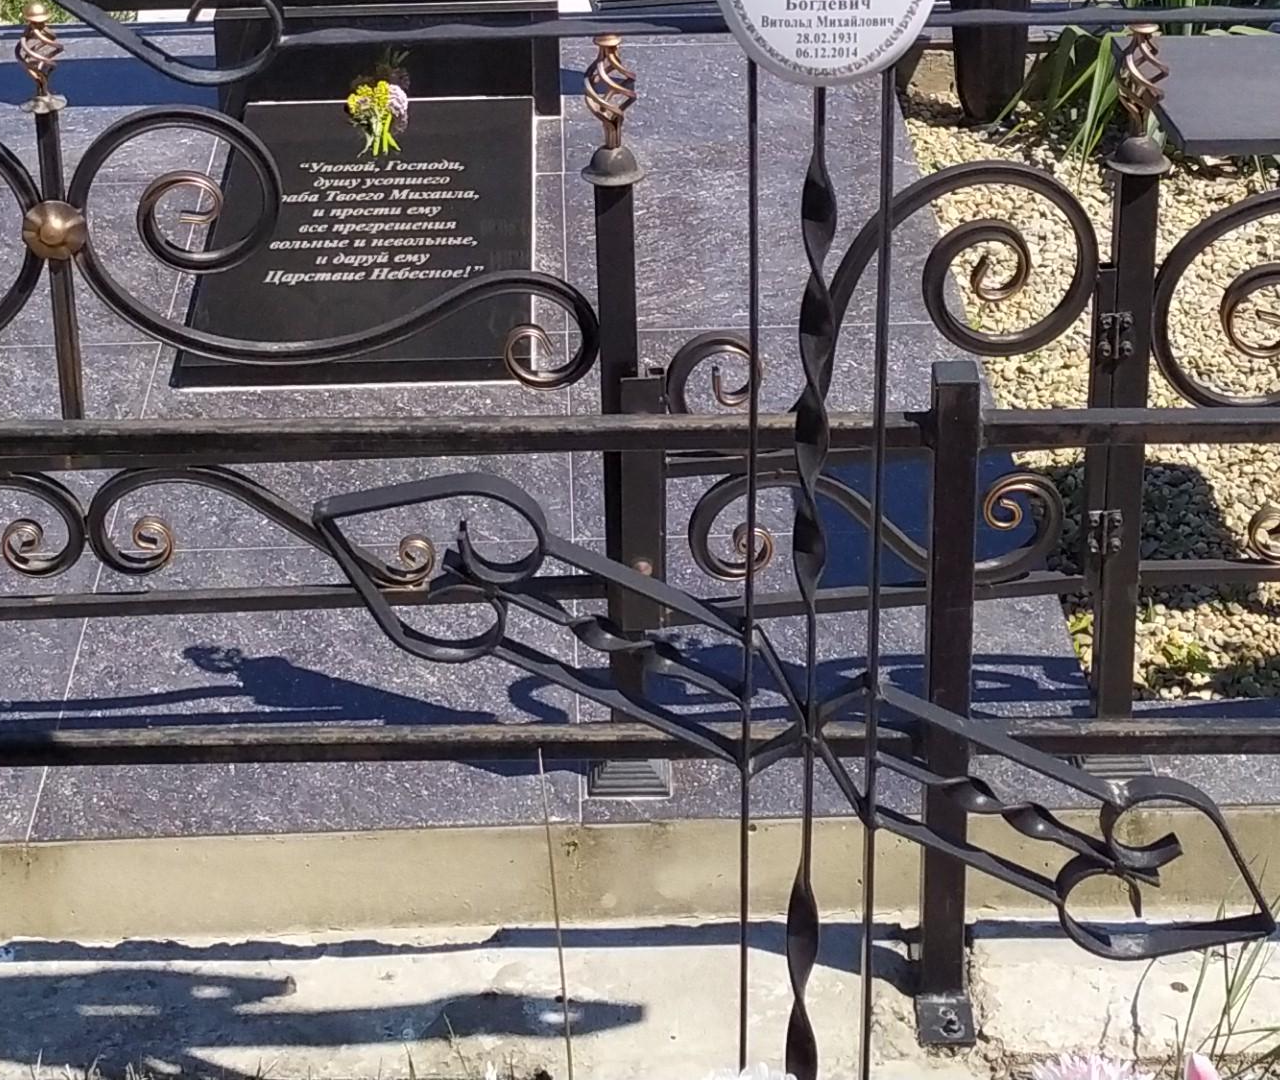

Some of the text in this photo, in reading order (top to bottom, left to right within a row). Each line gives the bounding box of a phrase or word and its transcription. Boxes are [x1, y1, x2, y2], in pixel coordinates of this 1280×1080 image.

[761, 15, 895, 28] Витольд Михайлович
[795, 32, 859, 44] 28.02.1931
[795, 47, 859, 59] 06.12.2014
[385, 159, 465, 172] Господи,
[313, 174, 450, 190] душу усопшего
[324, 190, 385, 203] Твоего
[388, 188, 480, 201] Михаила,
[312, 206, 442, 220] и прости ему
[299, 220, 457, 234] все прегрешения
[270, 234, 478, 250] вольные и невольные,
[316, 251, 430, 266] и даруй ему
[264, 270, 364, 285] Царствие
